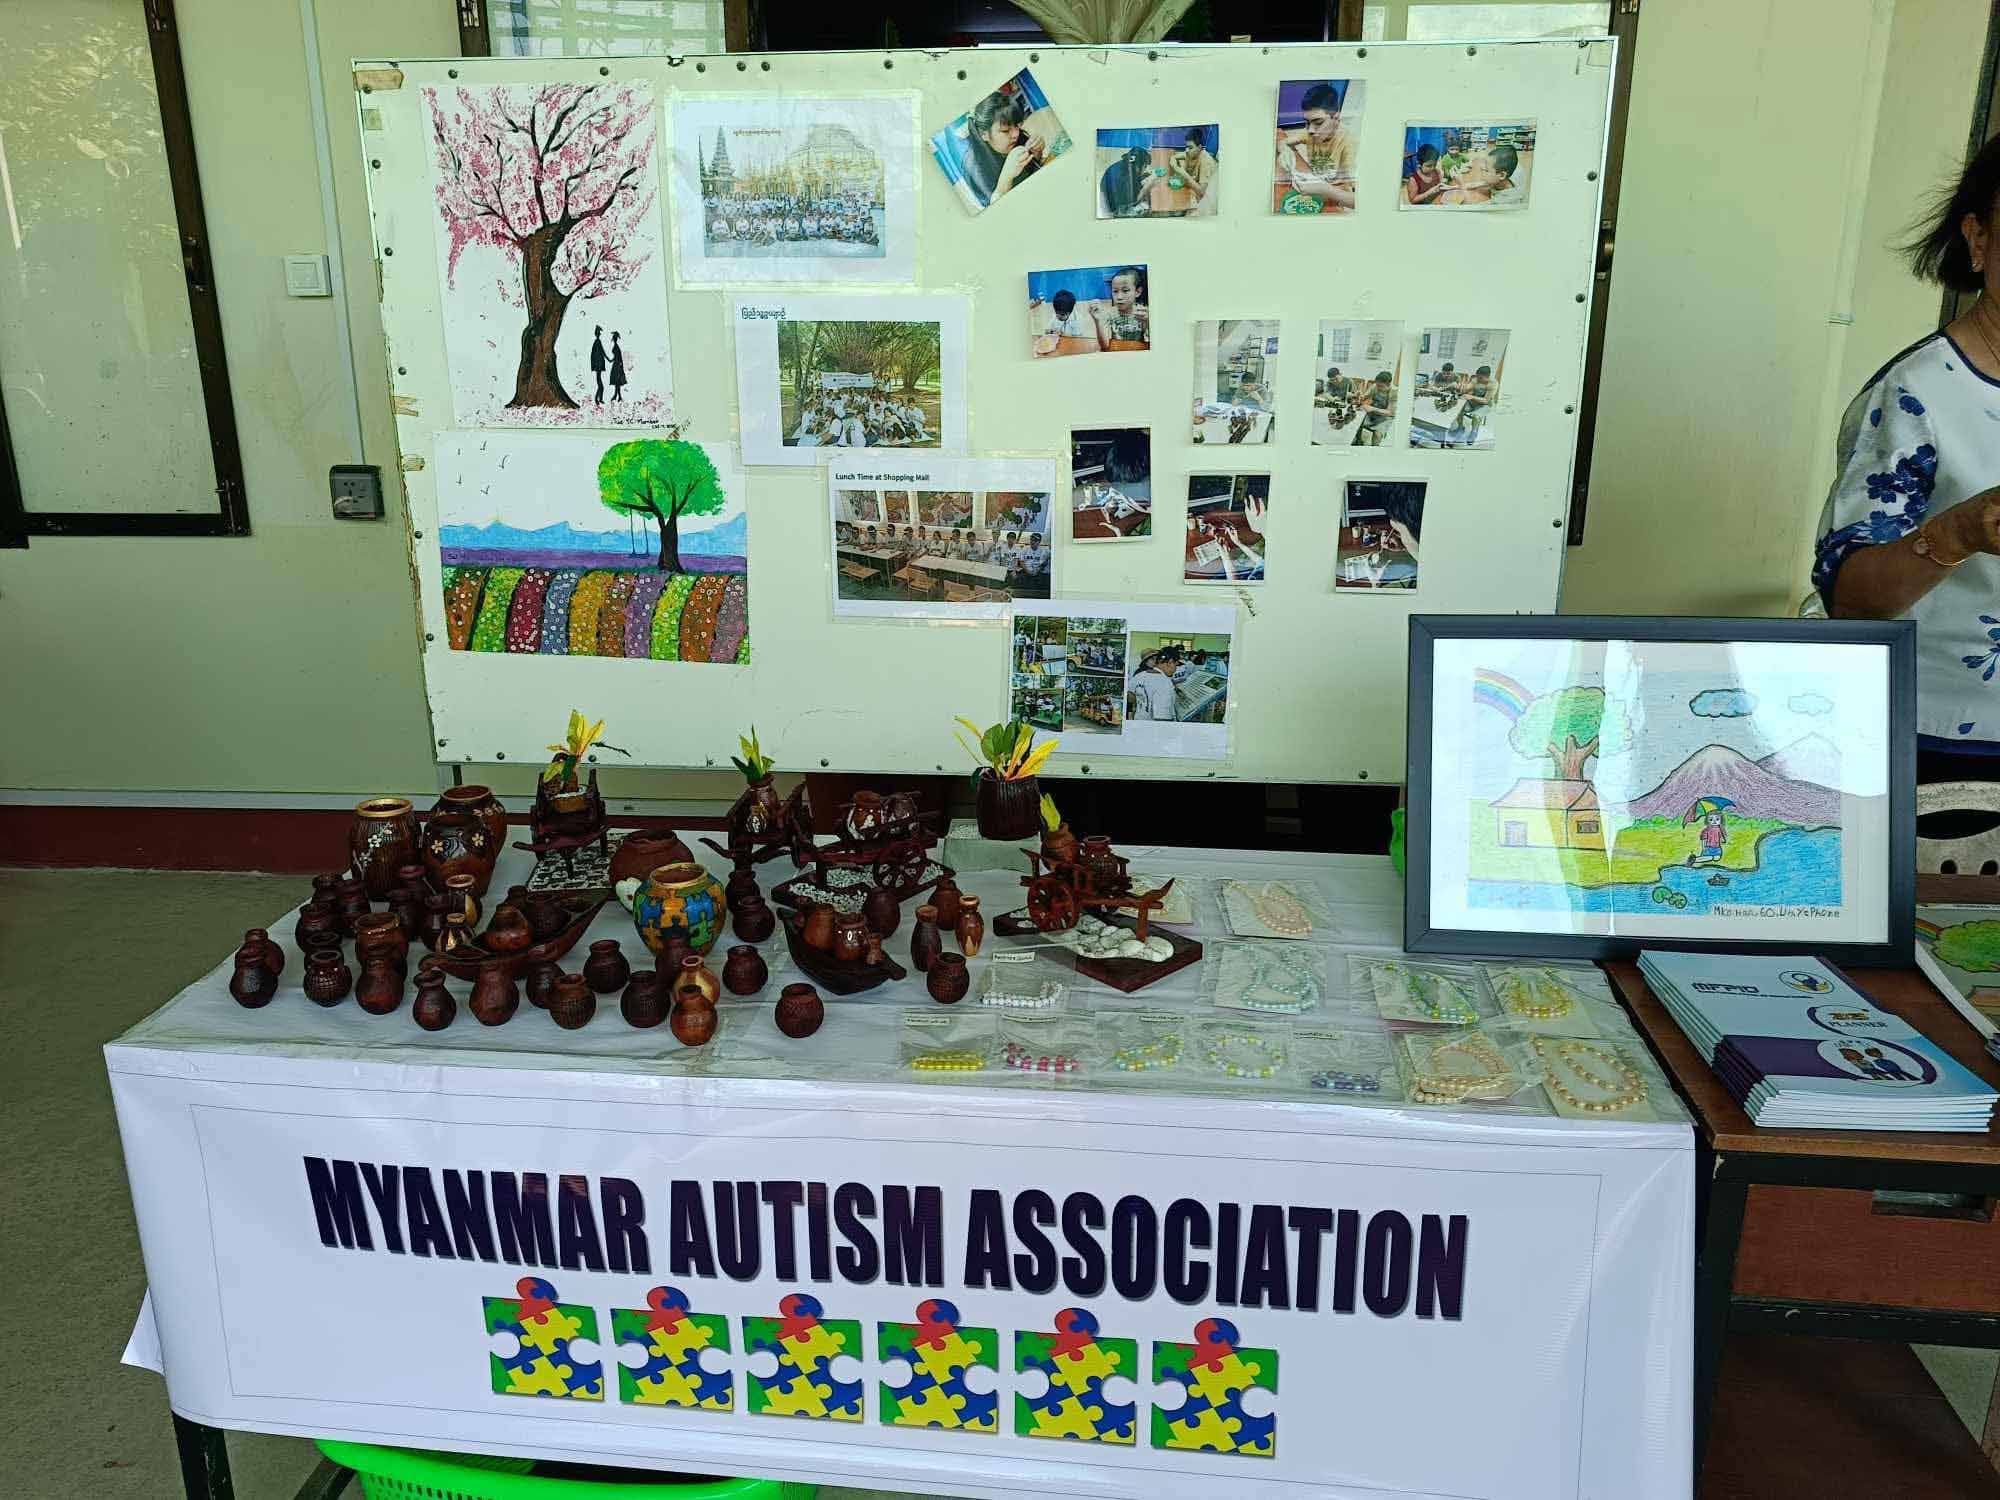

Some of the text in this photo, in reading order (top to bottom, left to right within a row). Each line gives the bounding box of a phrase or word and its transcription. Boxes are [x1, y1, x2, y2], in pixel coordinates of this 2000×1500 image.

[835, 473, 930, 483] Lunch Time at Shopping Mall
[304, 1156, 1469, 1321] MYANMAR AUTISM ASSOCIATION
